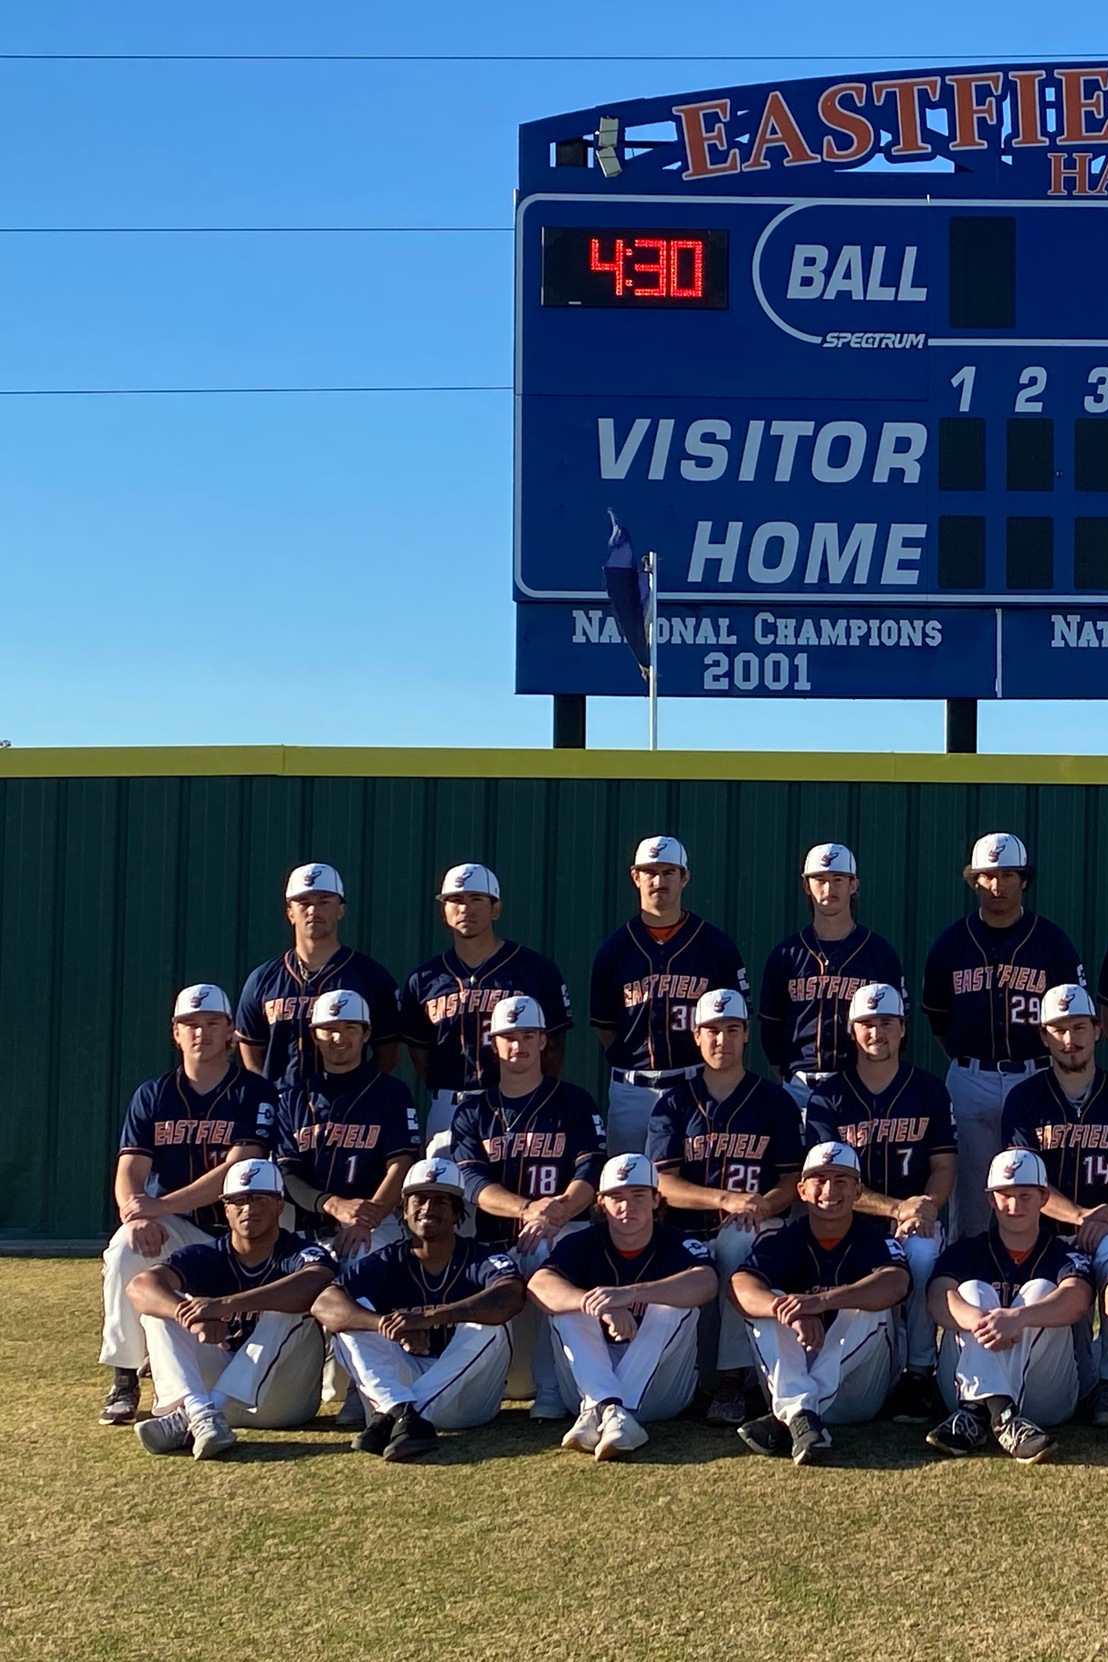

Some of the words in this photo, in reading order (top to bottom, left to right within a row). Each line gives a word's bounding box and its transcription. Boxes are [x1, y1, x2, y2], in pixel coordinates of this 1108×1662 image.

[590, 238, 704, 298] 4:30
[786, 244, 928, 302] BALL
[822, 332, 926, 349] SPECTRUM
[950, 365, 977, 412] 1
[1014, 365, 1048, 413] 2
[597, 417, 929, 485] VISITOR
[686, 519, 928, 586] HOME
[572, 609, 738, 645] NAONAL
[702, 651, 812, 691] 2001
[787, 975, 878, 1002] EASTFIE
[952, 963, 1047, 994] EASTFIELD
[425, 988, 525, 1024] EASTFIE
[1010, 995, 1042, 1025] 29
[154, 1119, 235, 1146] EASTFIEL
[346, 1155, 358, 1183] 1
[897, 1146, 913, 1177] 7
[527, 1165, 558, 1195] 18
[726, 1164, 761, 1194] 26
